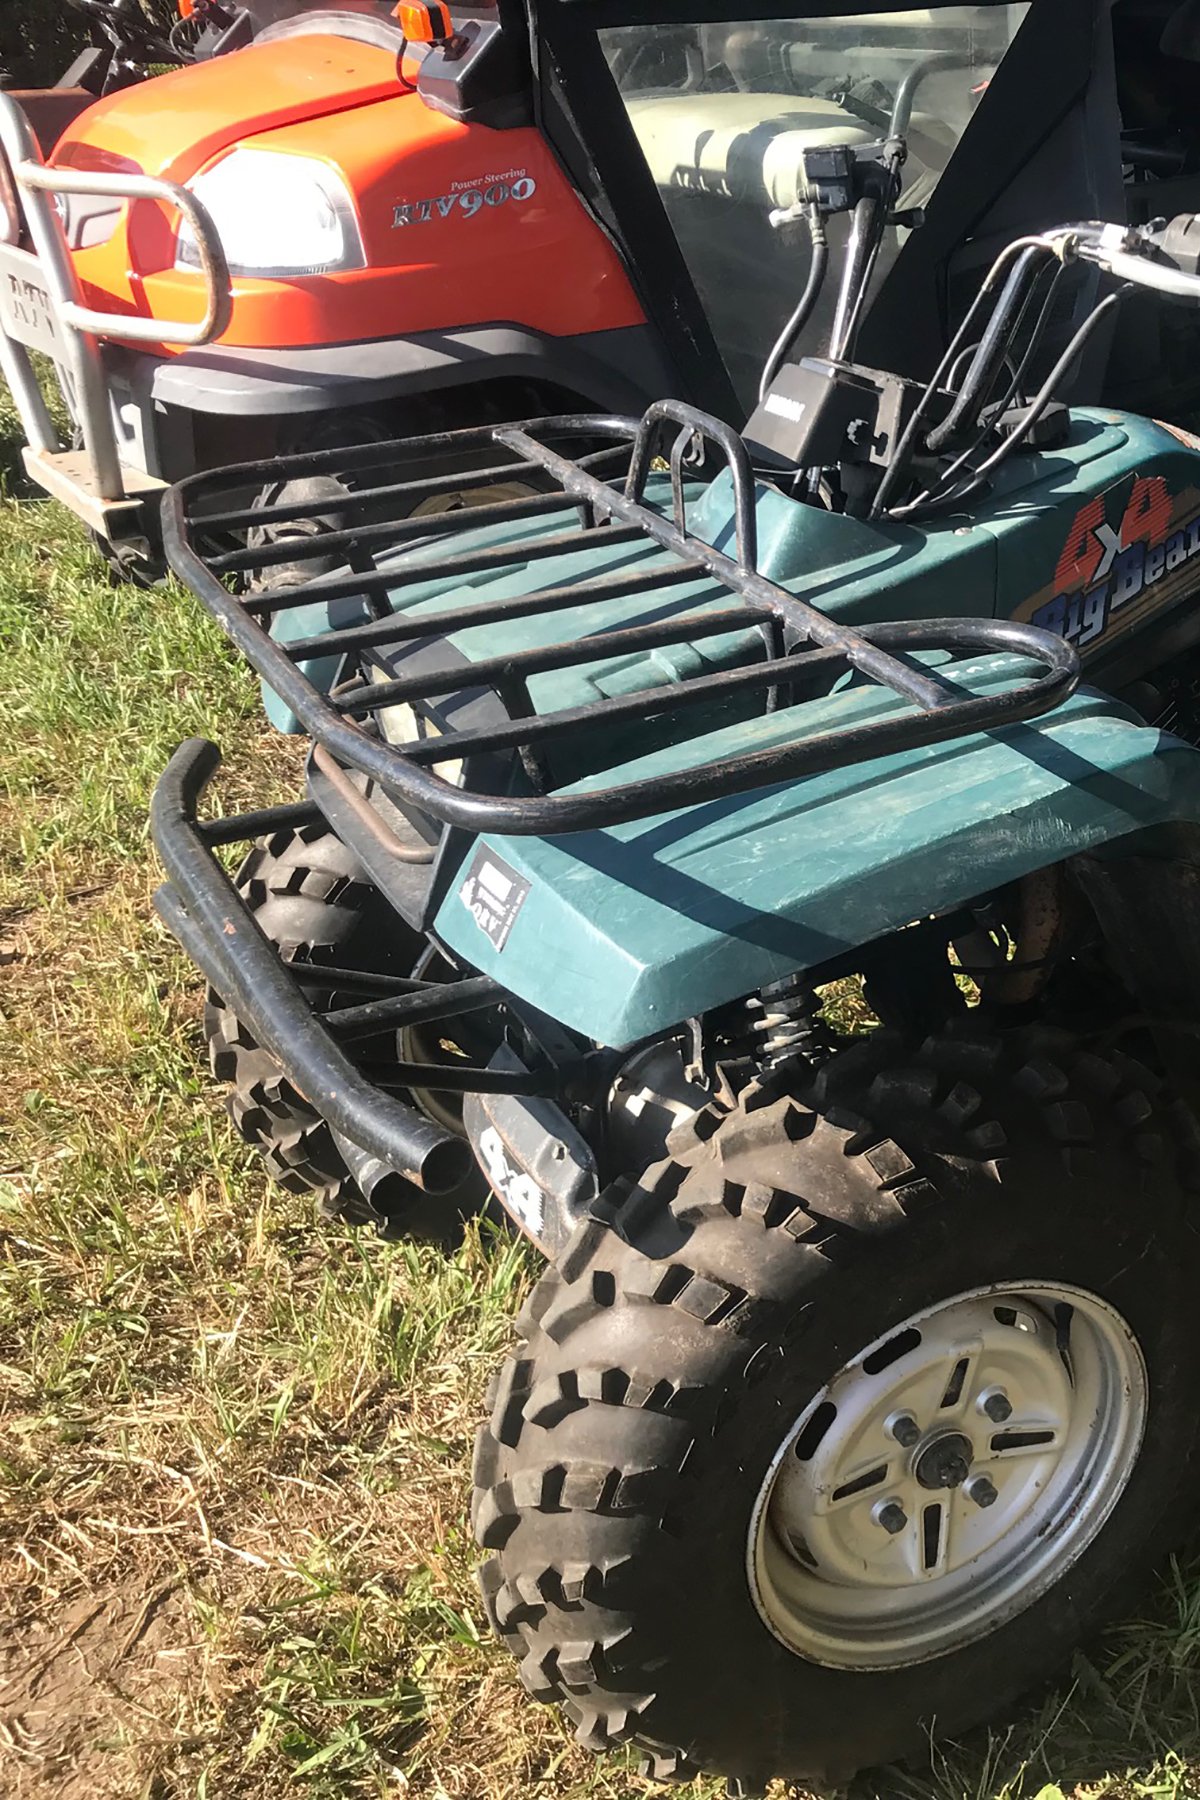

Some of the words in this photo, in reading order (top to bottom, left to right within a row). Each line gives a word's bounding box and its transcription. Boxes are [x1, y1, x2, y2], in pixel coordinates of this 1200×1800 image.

[451, 176, 483, 191] Power
[484, 168, 526, 184] Steering
[391, 177, 537, 229] RTV900
